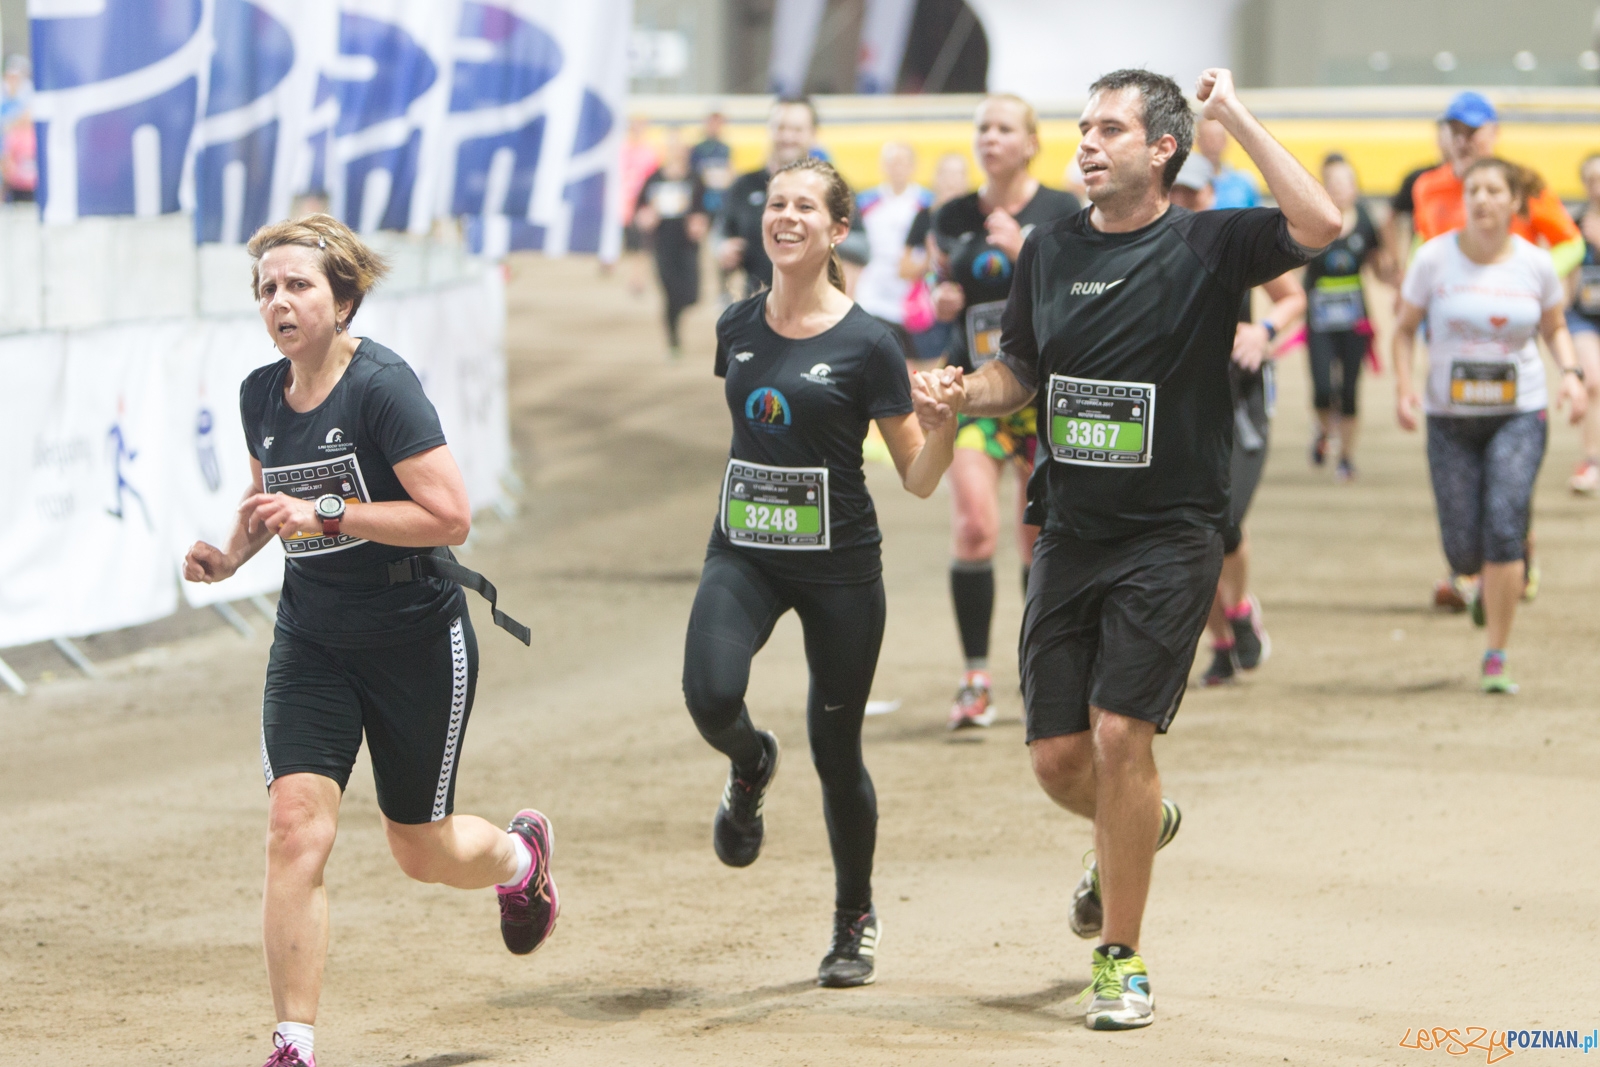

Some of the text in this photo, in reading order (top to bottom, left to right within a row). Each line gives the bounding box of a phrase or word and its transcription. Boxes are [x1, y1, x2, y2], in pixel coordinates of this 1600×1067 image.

[1070, 281, 1106, 296] RUN
[1065, 419, 1121, 449] 3367
[744, 503, 798, 532] 3248
